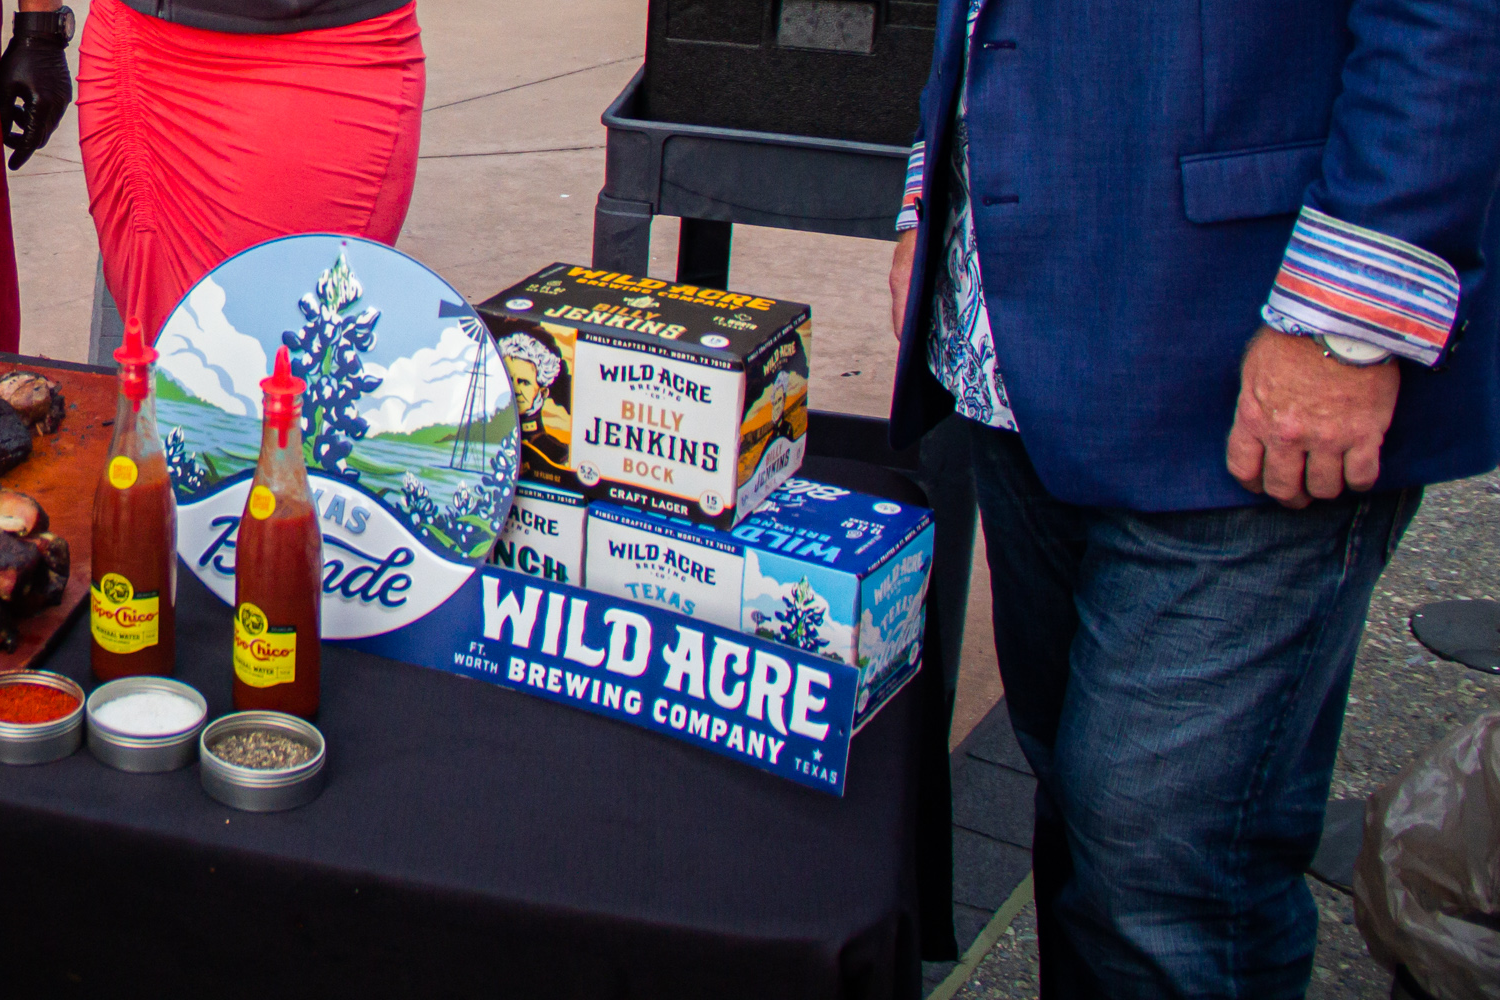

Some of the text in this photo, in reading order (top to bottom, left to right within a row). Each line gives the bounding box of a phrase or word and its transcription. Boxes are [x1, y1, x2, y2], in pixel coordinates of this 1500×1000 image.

[567, 267, 668, 291] WILD
[667, 286, 776, 311] ACRE
[575, 278, 653, 294] BREWING
[657, 291, 741, 310] COMPANY
[543, 304, 688, 341] JENKINS
[591, 302, 662, 320] BILLY
[585, 334, 732, 369] FINELY CRAFTED IN FT. WORTH, TX 76102
[600, 363, 712, 404] WILD ACRE
[629, 384, 682, 402] BREWING
[621, 400, 684, 433] BILLY
[584, 416, 720, 473] JENKINS
[623, 457, 675, 485] BOCK
[314, 489, 371, 534] XAS
[610, 488, 689, 516] CRAFT LAGER
[706, 494, 718, 505] 15
[509, 504, 559, 537] ACRE
[594, 510, 619, 523] FINELY
[621, 514, 652, 532] CRAFTED
[654, 523, 663, 534] IN
[705, 537, 715, 547] TX
[750, 517, 832, 542] BREWING
[731, 525, 841, 563] WILD
[199, 515, 415, 608] Bnde
[486, 539, 569, 583] NCH
[608, 539, 717, 586] WILD ACRE
[635, 562, 687, 582] BREWING
[624, 582, 696, 616] TEXAS
[114, 606, 159, 628] Chico
[120, 633, 140, 641] WATER
[250, 638, 294, 662] Chico
[253, 667, 275, 676] WATER
[454, 651, 499, 675] WORTH
[481, 574, 832, 741] WILD ACRE
[469, 641, 786, 764] FT. BREWING COMPANY
[794, 757, 838, 785] TEXAS
